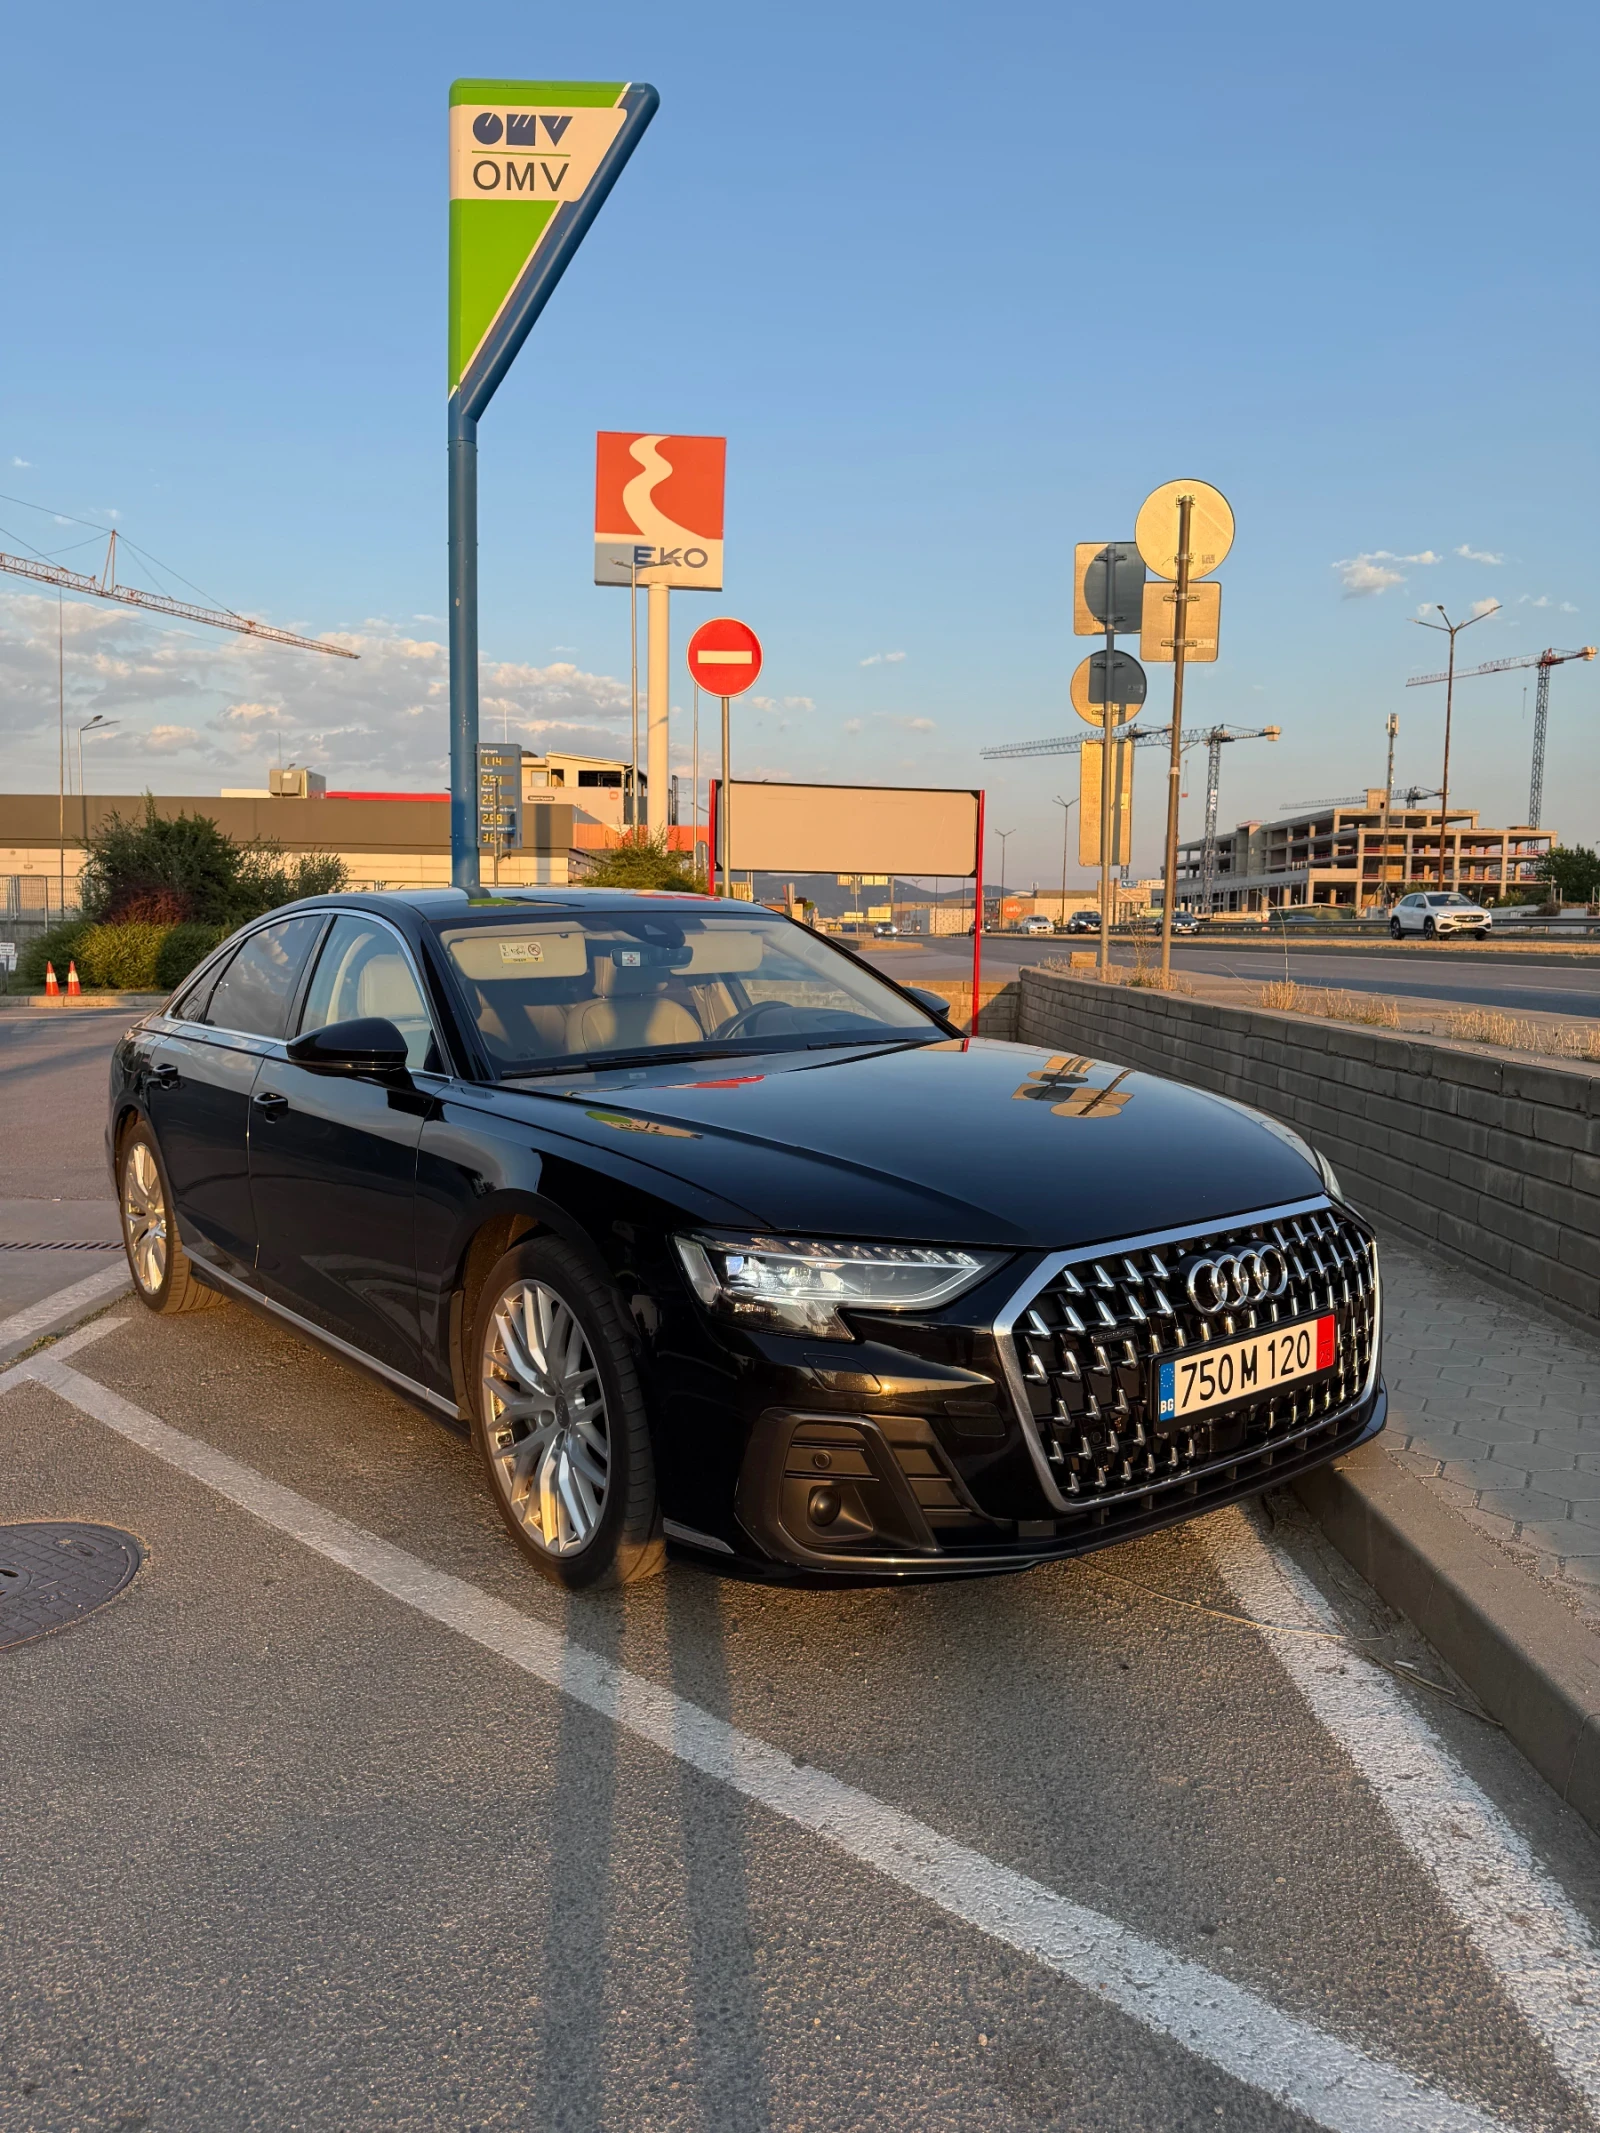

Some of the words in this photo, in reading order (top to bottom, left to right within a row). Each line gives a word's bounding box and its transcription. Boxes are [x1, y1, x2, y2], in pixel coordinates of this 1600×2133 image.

[472, 160, 570, 192] OMV
[634, 545, 709, 569] EKO
[1181, 1353, 1234, 1408] 750
[1240, 1345, 1258, 1389] M
[1267, 1329, 1311, 1380] 120
[1160, 1397, 1175, 1414] BG
